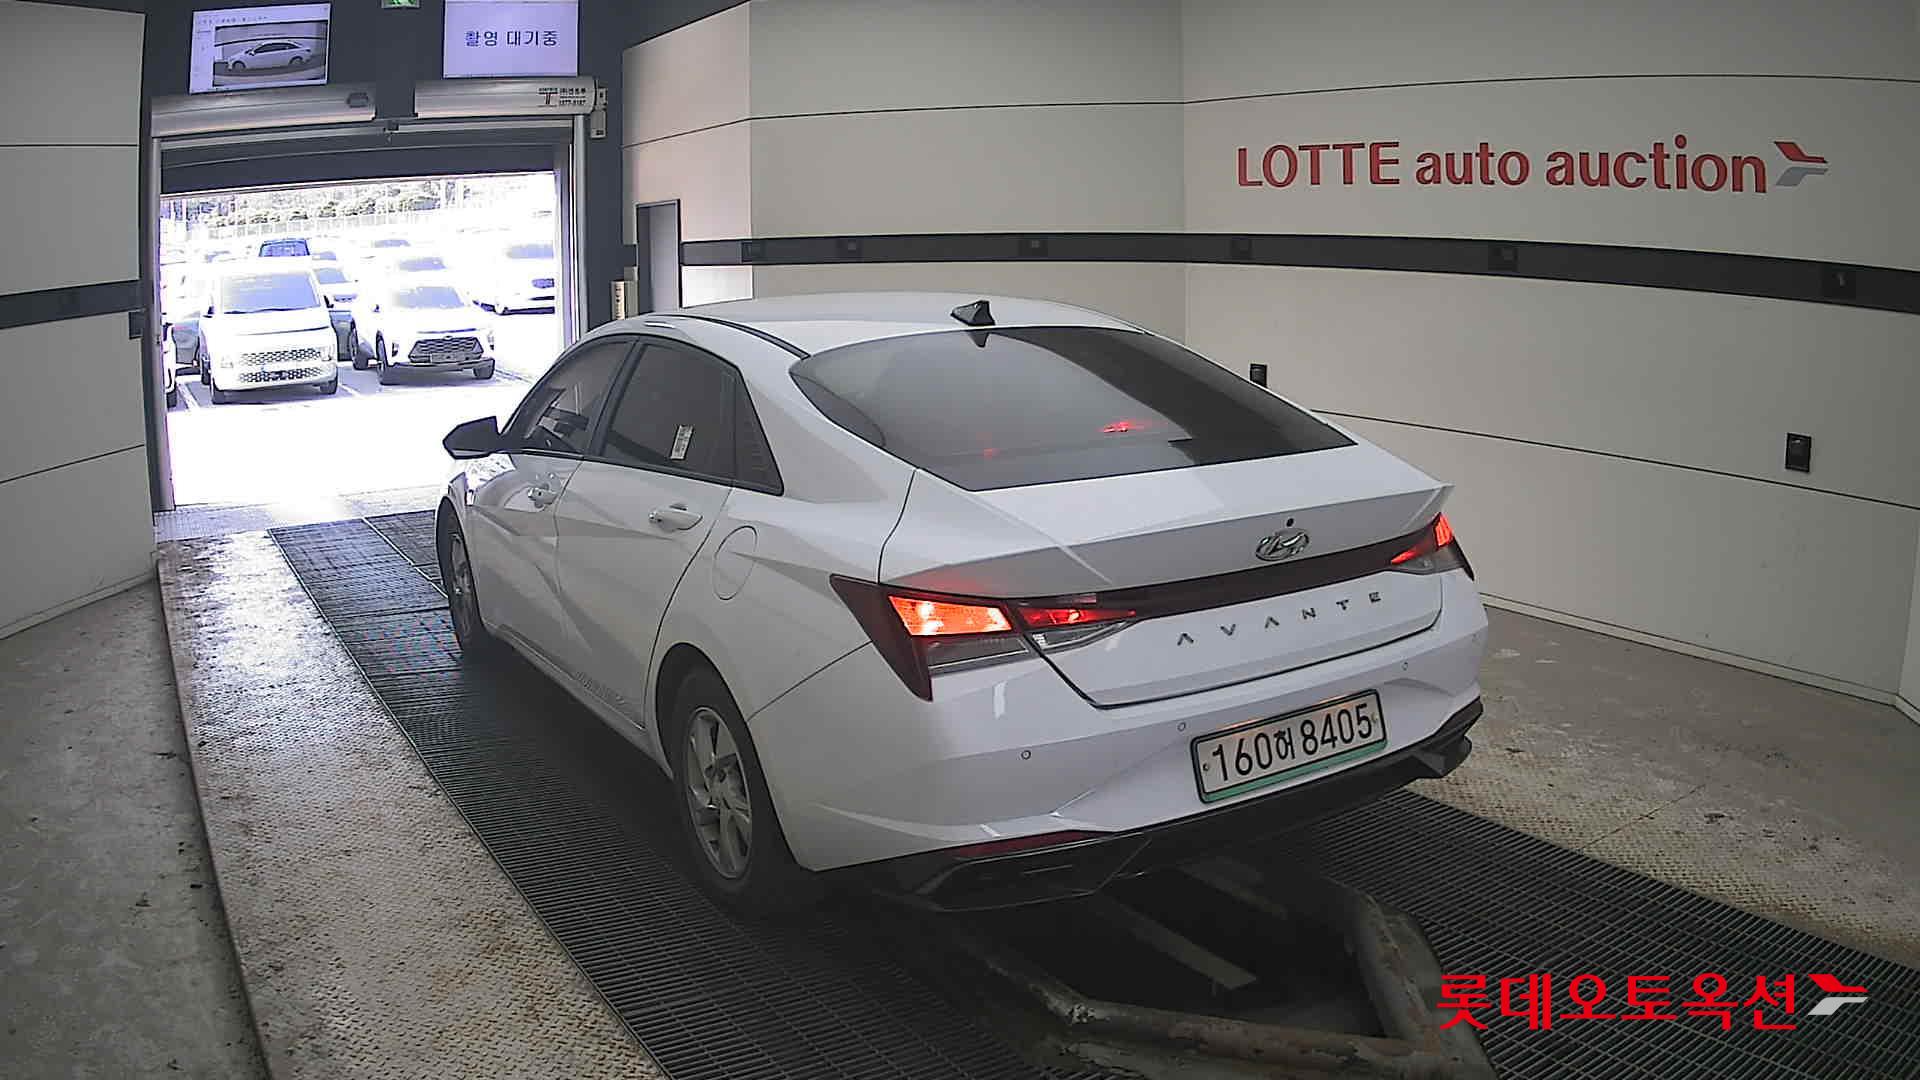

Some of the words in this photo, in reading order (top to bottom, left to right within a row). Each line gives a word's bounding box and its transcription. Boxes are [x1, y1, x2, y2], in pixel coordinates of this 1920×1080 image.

[507, 30, 557, 46] 대기중
[1237, 142, 1400, 187] LOTTE
[1416, 142, 1530, 186] auto
[1545, 134, 1768, 194] auction
[1177, 591, 1382, 646] AVANTE
[1211, 726, 1296, 782] 160허
[1300, 702, 1373, 756] 8405
